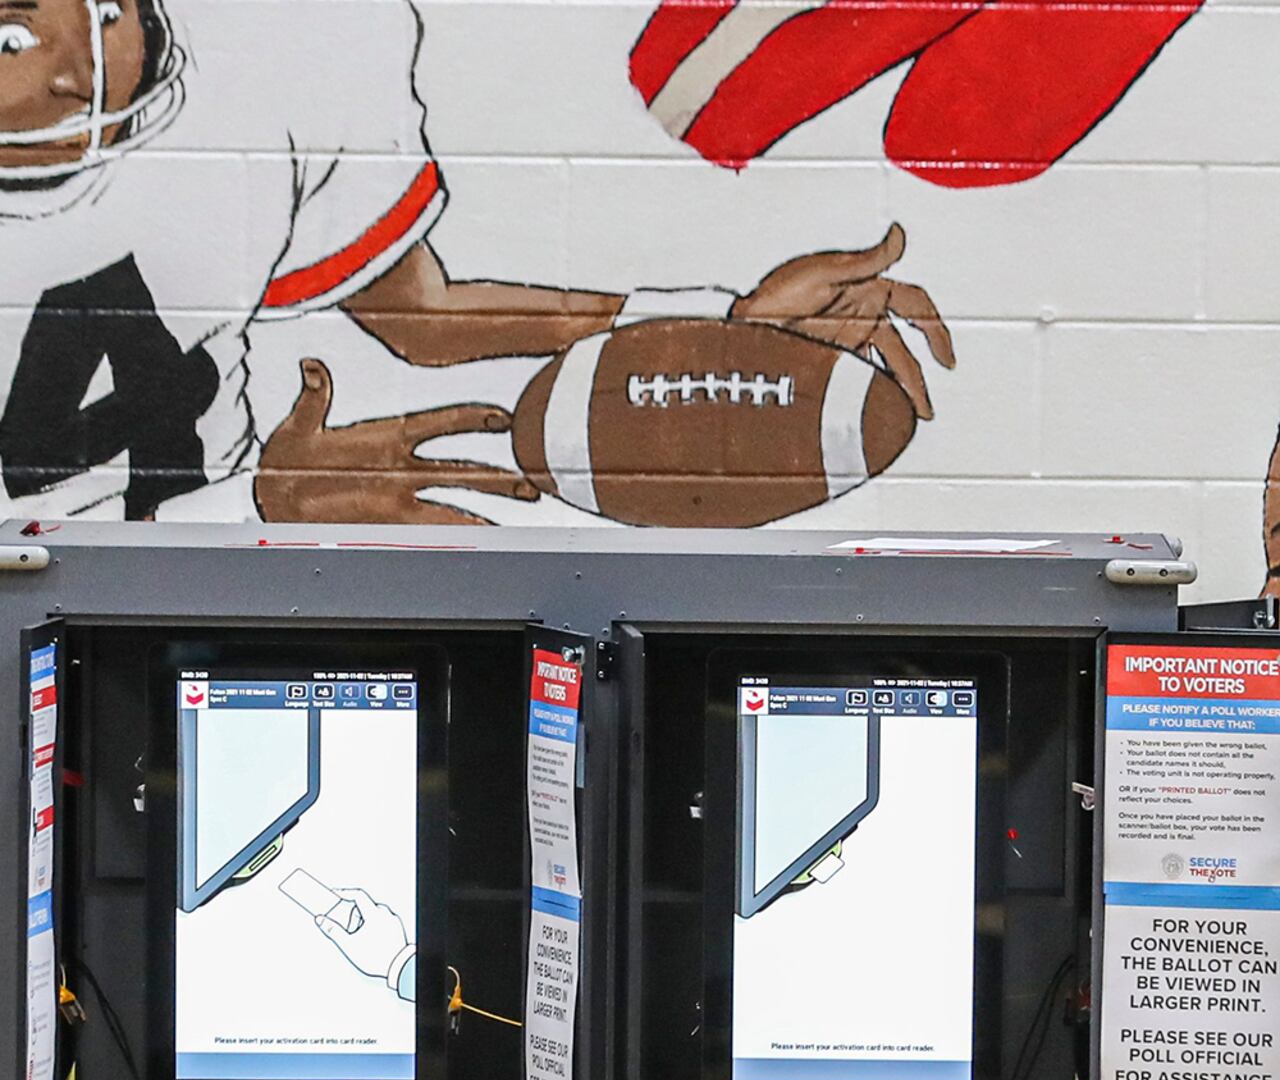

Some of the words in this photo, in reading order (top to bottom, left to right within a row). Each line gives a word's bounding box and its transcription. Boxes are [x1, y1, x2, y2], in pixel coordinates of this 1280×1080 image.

[1125, 657, 1218, 673] IMPORTANT
[1220, 658, 1280, 675] NOTICE
[1158, 676, 1181, 692] TO
[1182, 677, 1245, 693] VOTERS
[1122, 703, 1161, 714] PLEASE
[1161, 704, 1200, 714] NOTIFY
[1200, 705, 1209, 715] A
[1210, 706, 1236, 716] POLL
[1148, 717, 1159, 727] IF
[1159, 717, 1183, 728] YOU
[1184, 718, 1225, 729] BELIEVE
[1226, 719, 1255, 730] THAT:
[1182, 741, 1204, 749] given
[1219, 742, 1243, 750] wrong
[1144, 749, 1167, 757] ballot
[1231, 751, 1241, 759] all
[1126, 768, 1140, 776] The
[1142, 770, 1166, 778] voting
[1205, 771, 1242, 780] operating
[1118, 784, 1131, 793] OR
[1232, 788, 1252, 796] does
[1118, 795, 1143, 803] reflect
[1118, 811, 1138, 819] Once
[1220, 814, 1242, 822] ballot
[1118, 822, 1171, 830] scanner/ballot
[1190, 824, 1207, 832] your
[1227, 824, 1241, 832] has
[1190, 858, 1236, 867] SECURE
[543, 925, 552, 940] FOR
[1152, 918, 1189, 933] FOR
[1194, 920, 1247, 935] YOUR
[1130, 937, 1269, 955] CONVENIENCE,
[1121, 955, 1156, 970] THE
[1162, 957, 1233, 972] BALLOT
[1238, 959, 1277, 974] CAN
[1136, 975, 1159, 990] BE
[1165, 977, 1236, 992] VIEWED
[1242, 979, 1260, 993] IN
[1130, 995, 1202, 1010] LARGER
[1207, 997, 1266, 1012] PRINT.
[214, 1036, 237, 1044] Please
[339, 1037, 355, 1045] card
[1120, 1029, 1188, 1044] PLEASE
[1194, 1031, 1227, 1046] SEE
[1232, 1032, 1273, 1047] OUR
[771, 1042, 794, 1050] Please
[1129, 1048, 1175, 1063] POLL
[1180, 1050, 1263, 1066] OFFICIAL
